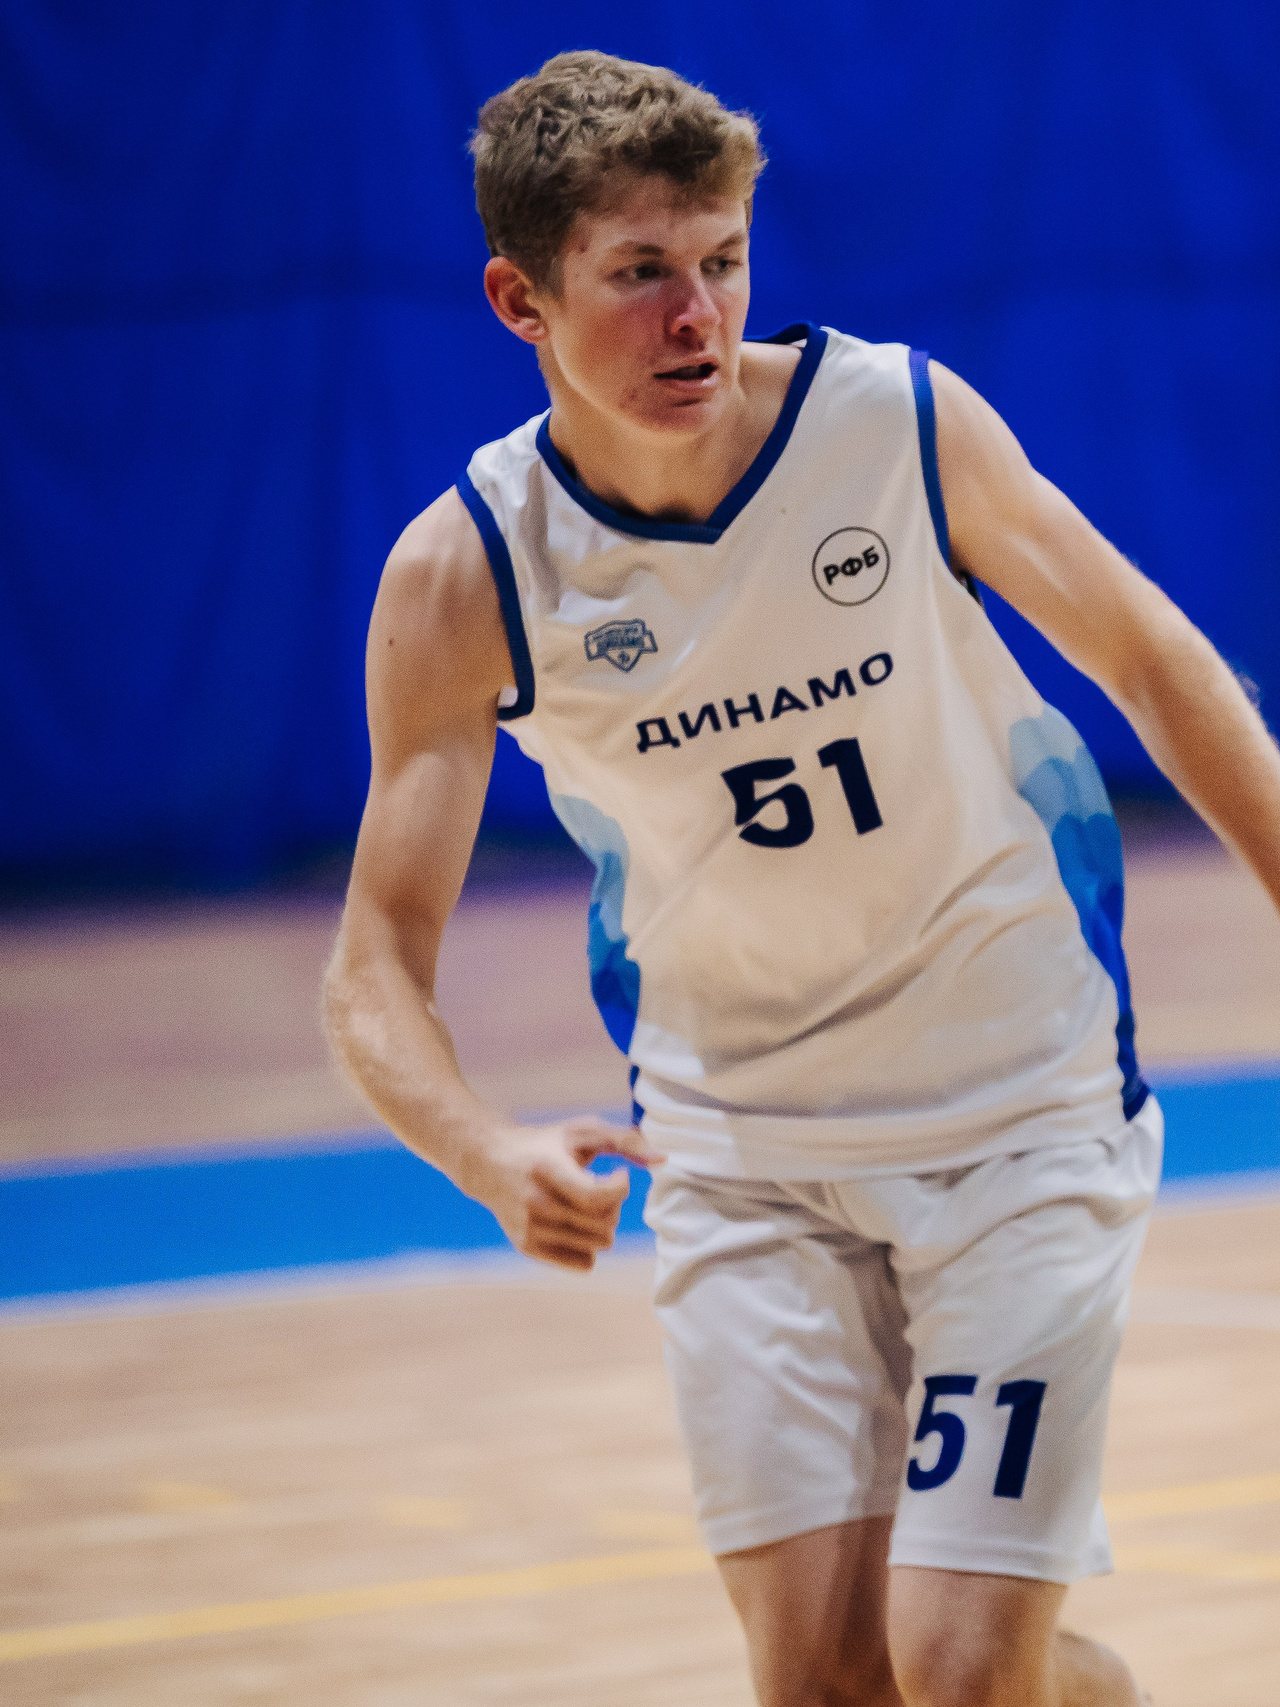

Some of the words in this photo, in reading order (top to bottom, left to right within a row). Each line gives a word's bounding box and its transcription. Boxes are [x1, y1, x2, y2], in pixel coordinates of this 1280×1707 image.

[823, 546, 880, 585] РФБ
[636, 652, 893, 753] ДИНАМО
[721, 737, 883, 848] 51
[906, 1374, 1048, 1499] 51
